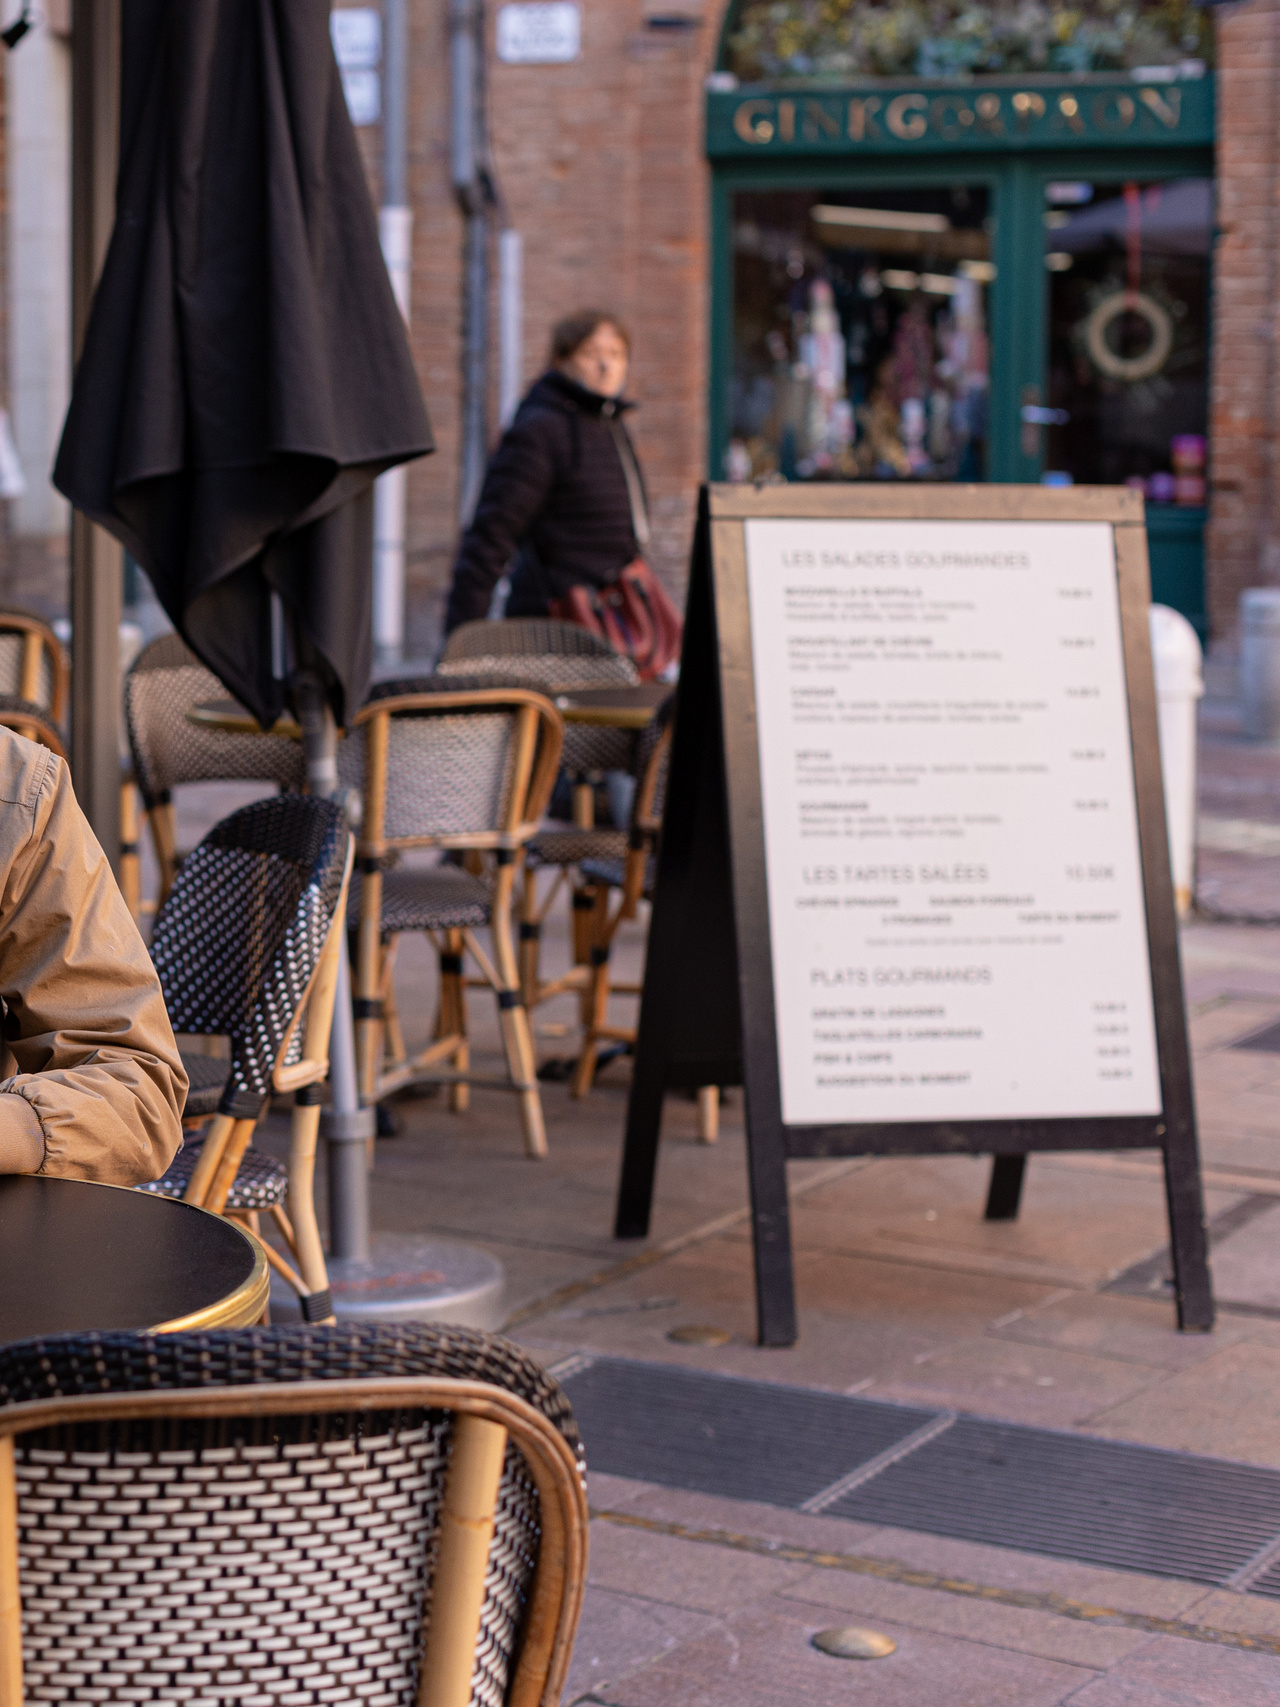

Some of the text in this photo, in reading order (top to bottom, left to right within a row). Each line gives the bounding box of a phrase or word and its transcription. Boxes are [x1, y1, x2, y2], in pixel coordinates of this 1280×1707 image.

[781, 550, 1031, 569] LES SALADES GOURMANDES
[802, 866, 839, 885] LES
[843, 865, 915, 883] TARTES
[809, 966, 993, 987] PLATS GOURMANDS
